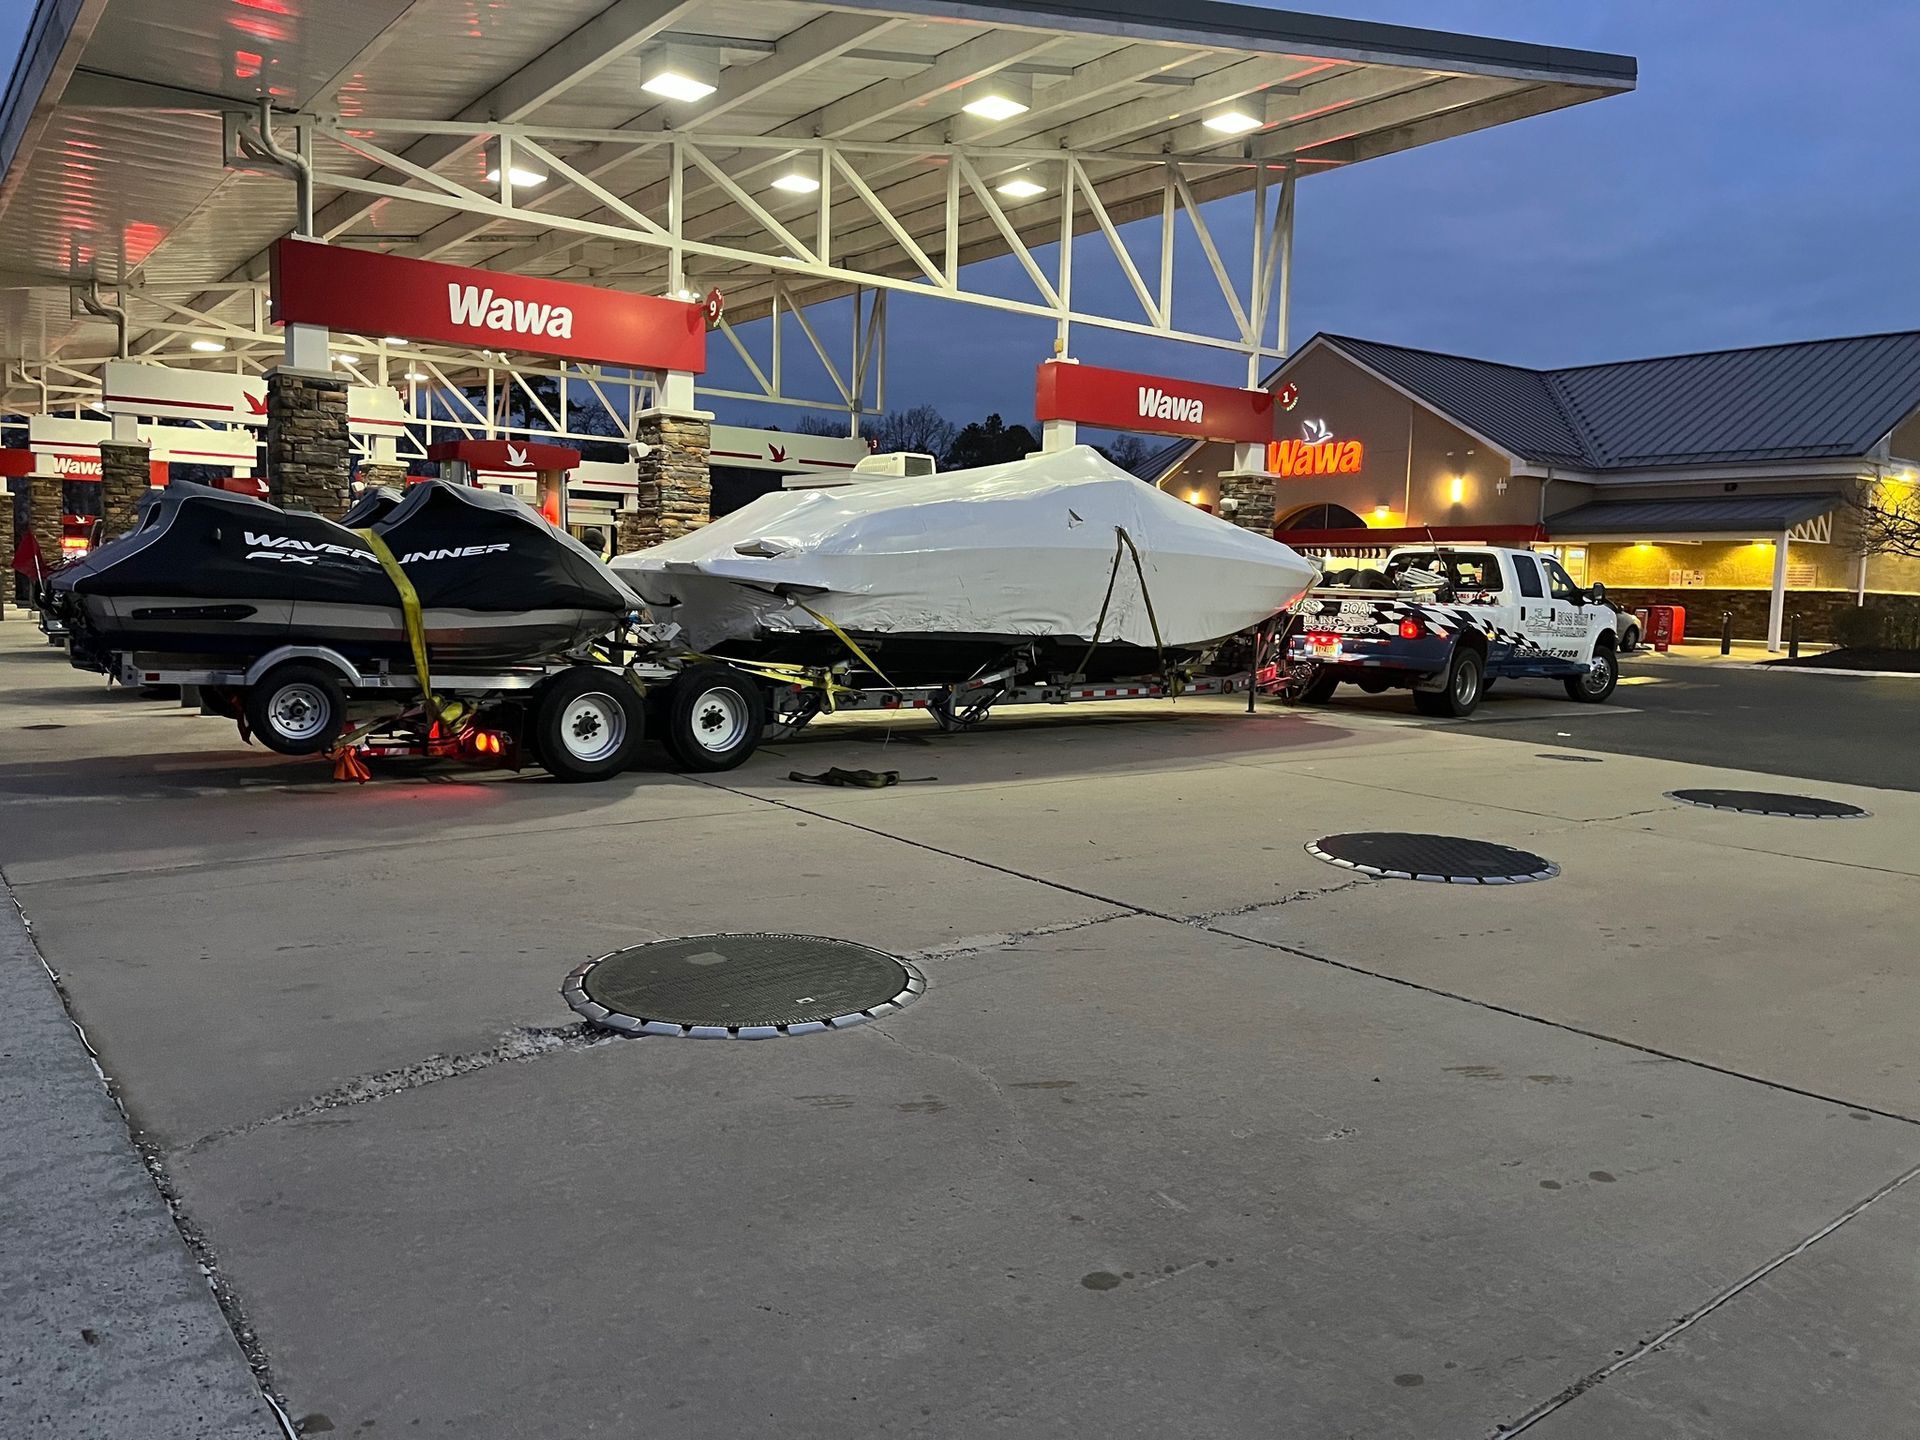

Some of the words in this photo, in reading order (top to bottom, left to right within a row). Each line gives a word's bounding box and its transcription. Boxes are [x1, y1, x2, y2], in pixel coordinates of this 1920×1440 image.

[448, 283, 573, 339] Wawa
[710, 300, 717, 317] 9
[1283, 391, 1290, 403] 1
[1138, 386, 1204, 424] Wawa
[872, 439, 878, 449] 3
[1268, 439, 1363, 477] Wawa
[53, 457, 104, 476] Wawa
[246, 551, 319, 565] FX
[1287, 601, 1318, 615] BOSS
[1341, 602, 1376, 615] BOAT
[1514, 648, 1579, 658] 732-267-7898
